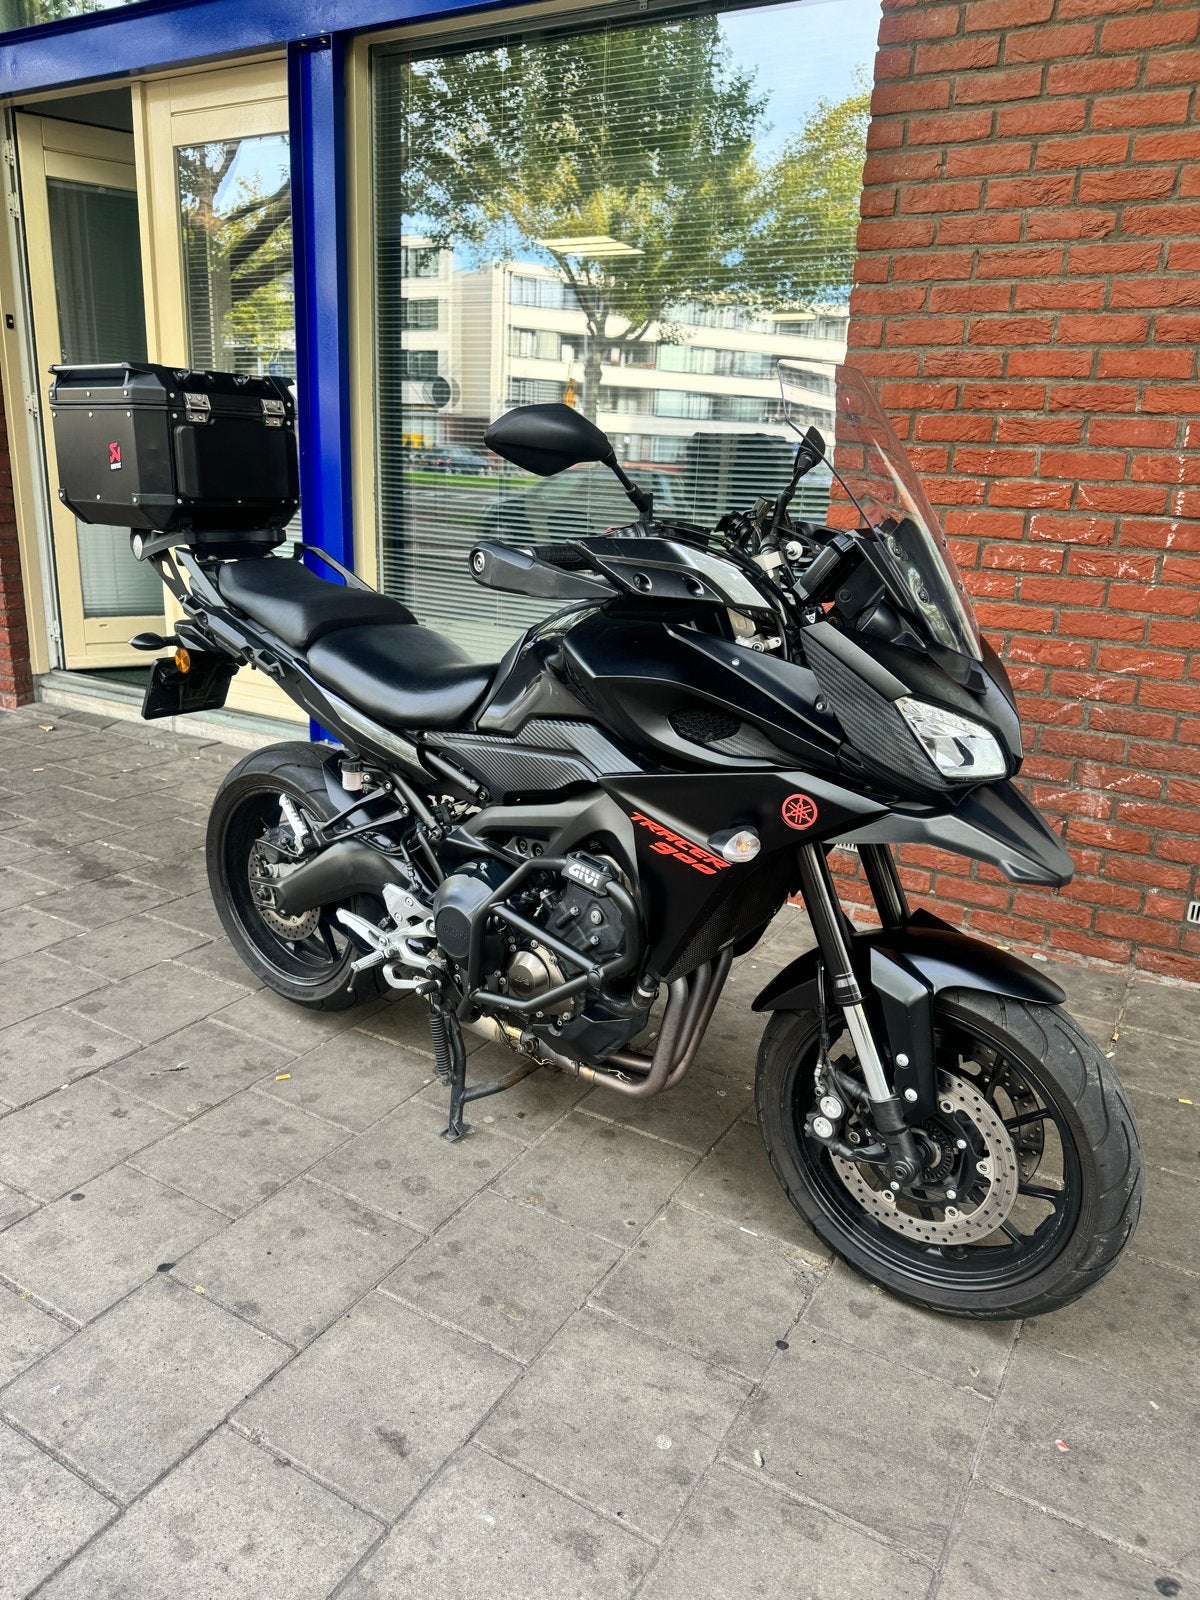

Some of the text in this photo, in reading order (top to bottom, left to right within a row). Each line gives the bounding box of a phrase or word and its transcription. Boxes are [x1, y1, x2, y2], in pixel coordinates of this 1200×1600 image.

[630, 811, 731, 870] TRACER
[568, 863, 600, 887] GIVI
[649, 841, 717, 875] 900
